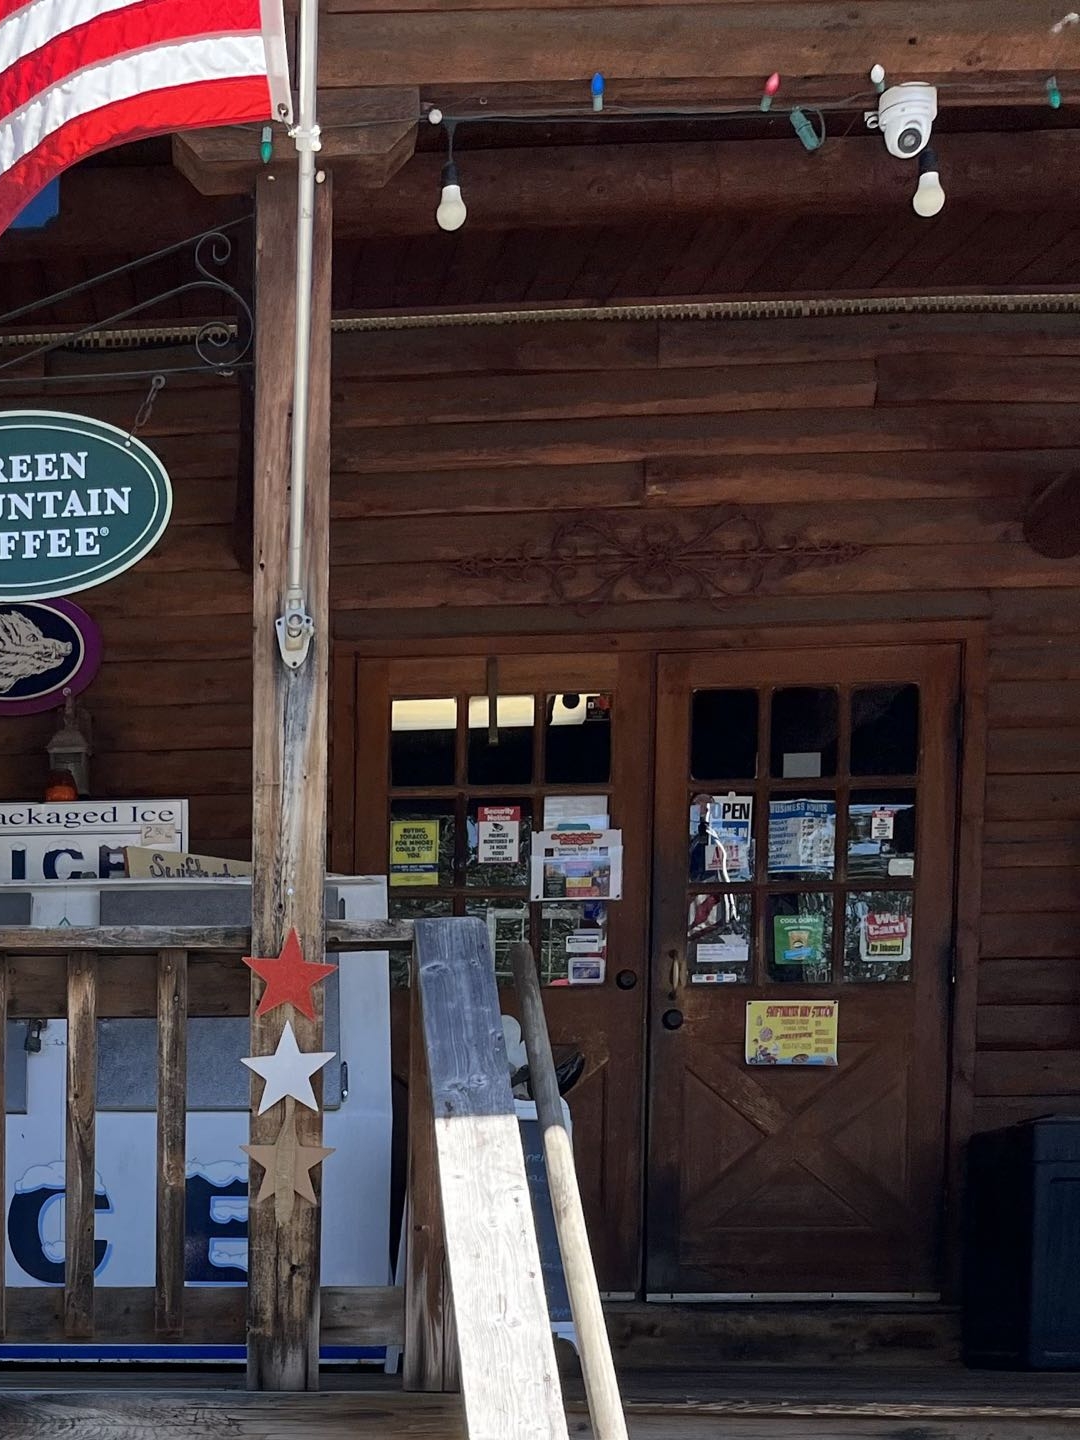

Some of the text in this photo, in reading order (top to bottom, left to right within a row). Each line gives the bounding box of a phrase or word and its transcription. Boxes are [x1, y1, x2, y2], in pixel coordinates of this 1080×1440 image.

[130, 806, 174, 823] Ice
[483, 807, 515, 816] Security
[710, 802, 751, 820] OPEN
[769, 802, 805, 813] BUSINESS
